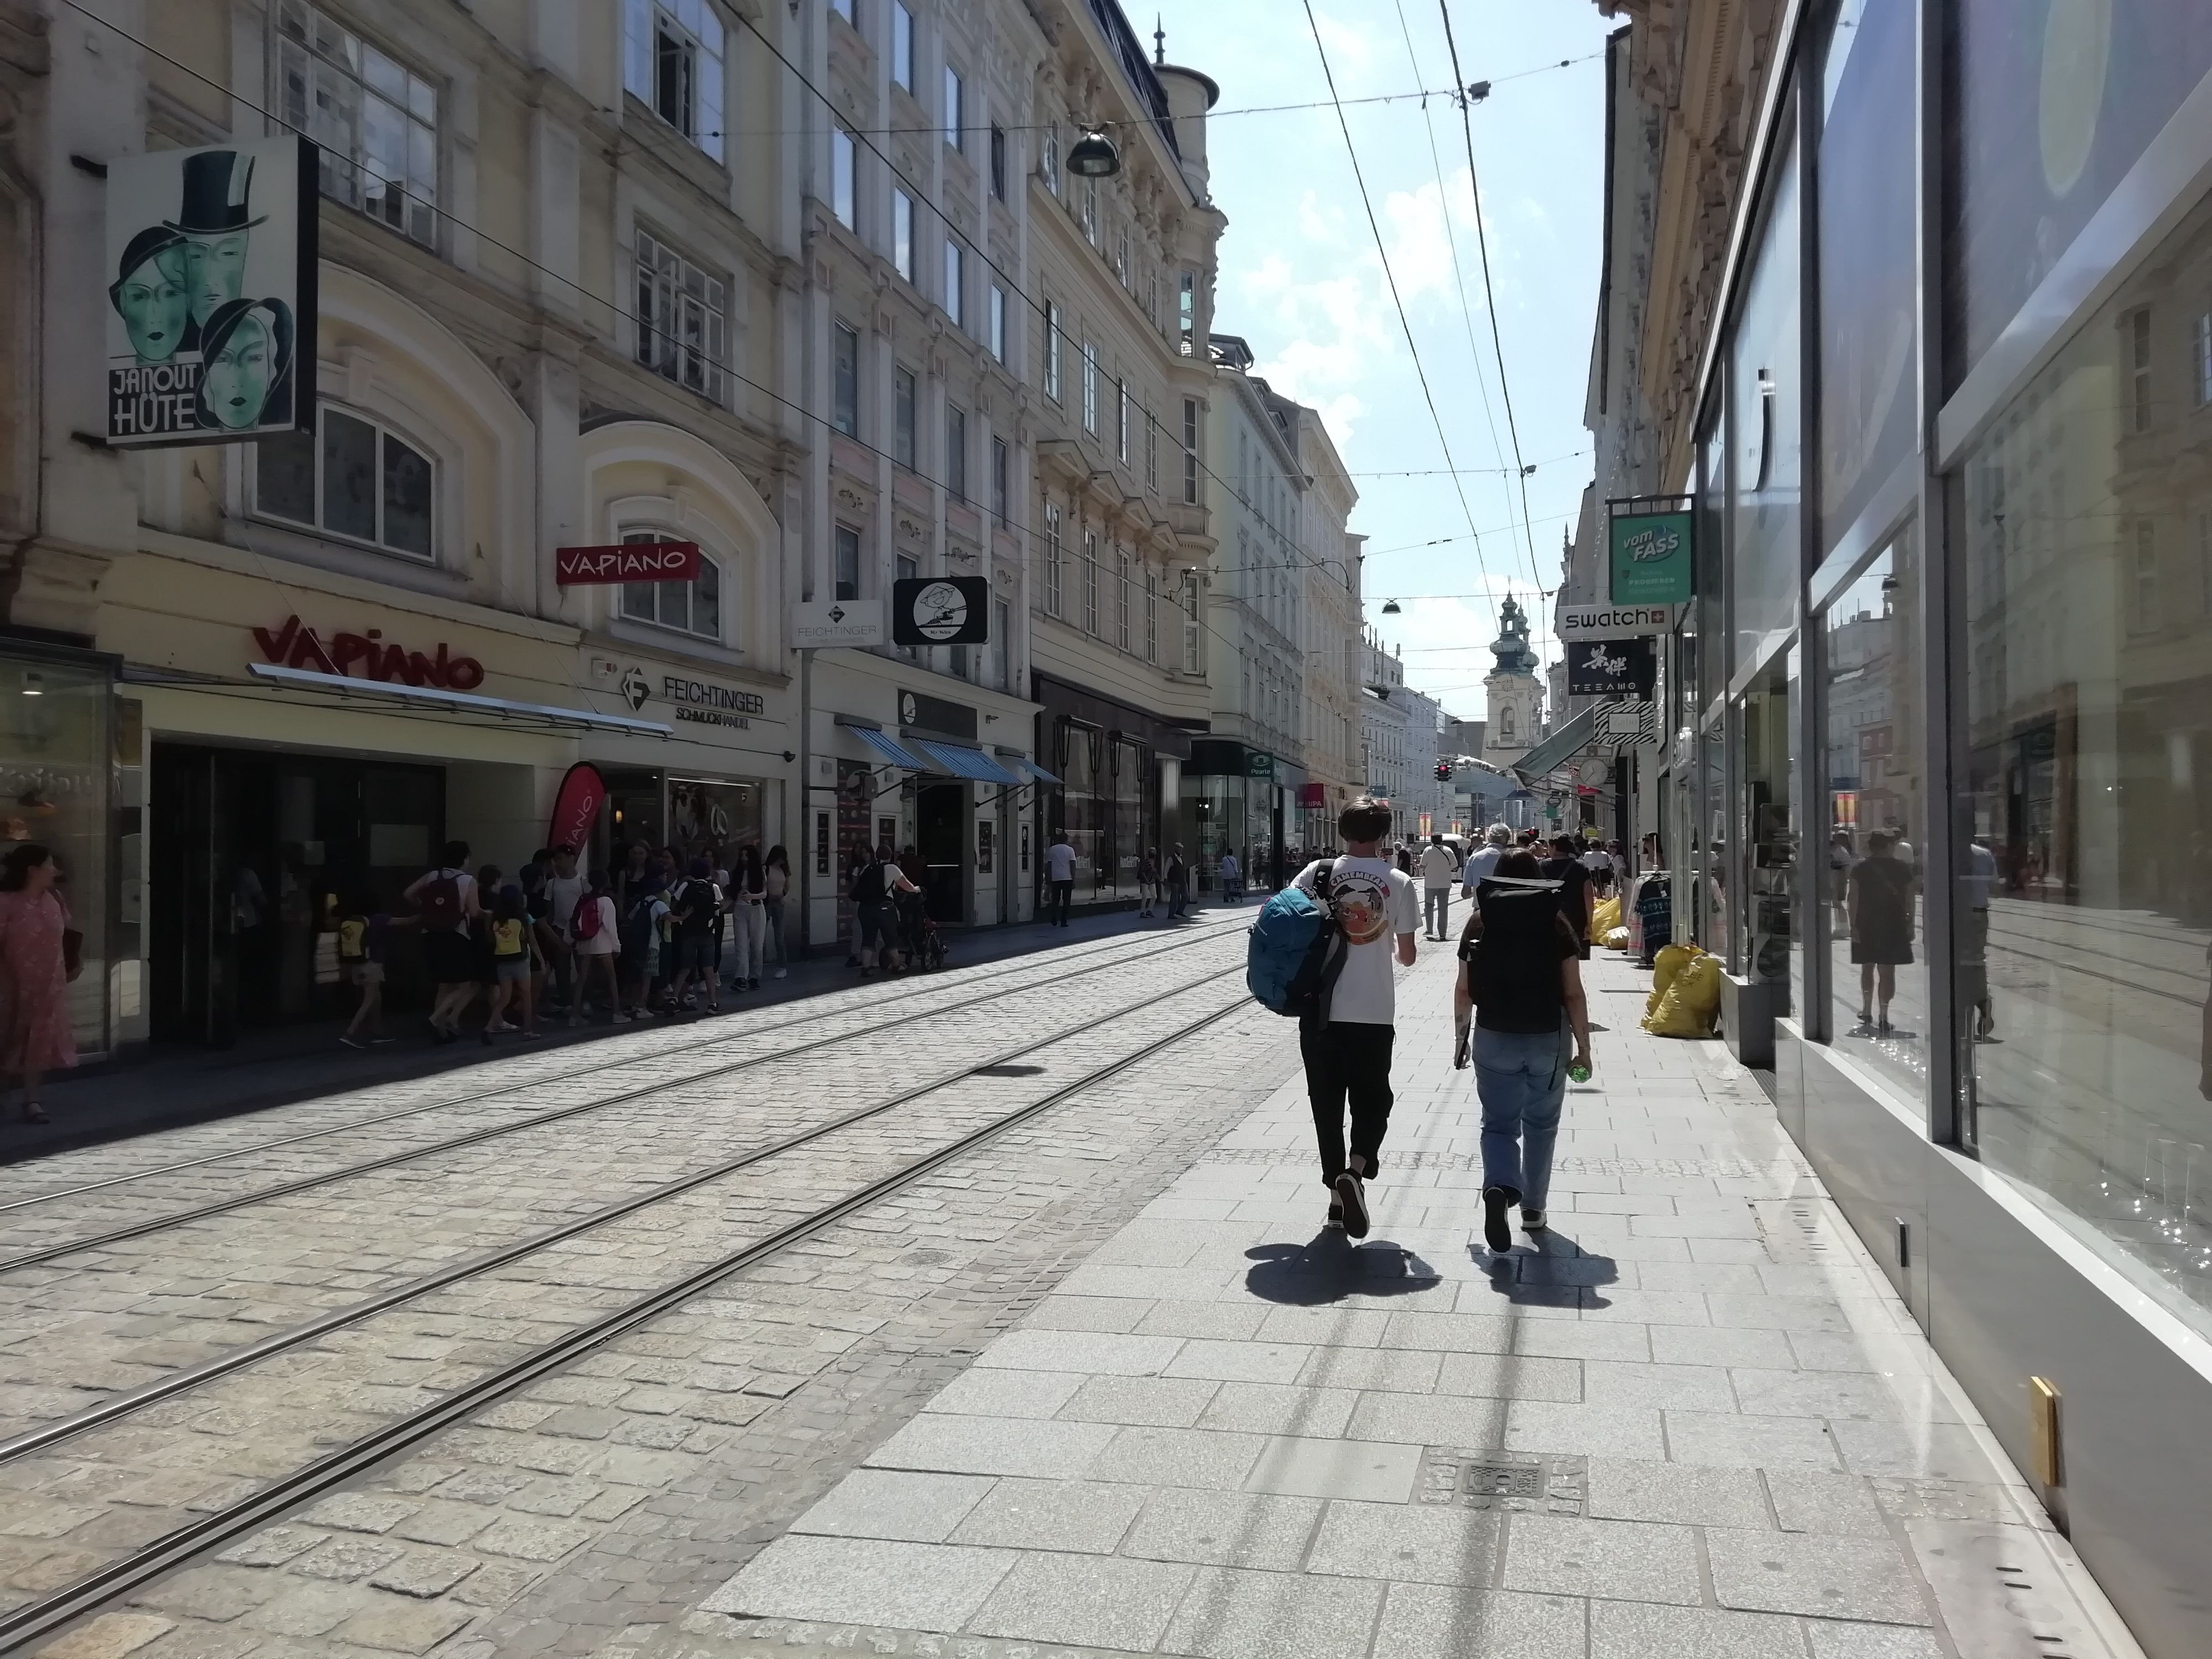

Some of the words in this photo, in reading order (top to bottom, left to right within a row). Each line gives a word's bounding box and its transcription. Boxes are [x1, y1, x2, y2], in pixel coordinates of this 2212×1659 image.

[114, 364, 197, 395] JANOUT
[114, 392, 195, 434] HÜTE
[1624, 530, 1652, 549] vom
[1634, 533, 1679, 562] FASS
[798, 625, 877, 637] FEICHTINGER
[1566, 608, 1648, 629] swatch
[663, 676, 764, 714] FEICHTINGER
[1330, 872, 1387, 889] CAMEMBEAR
